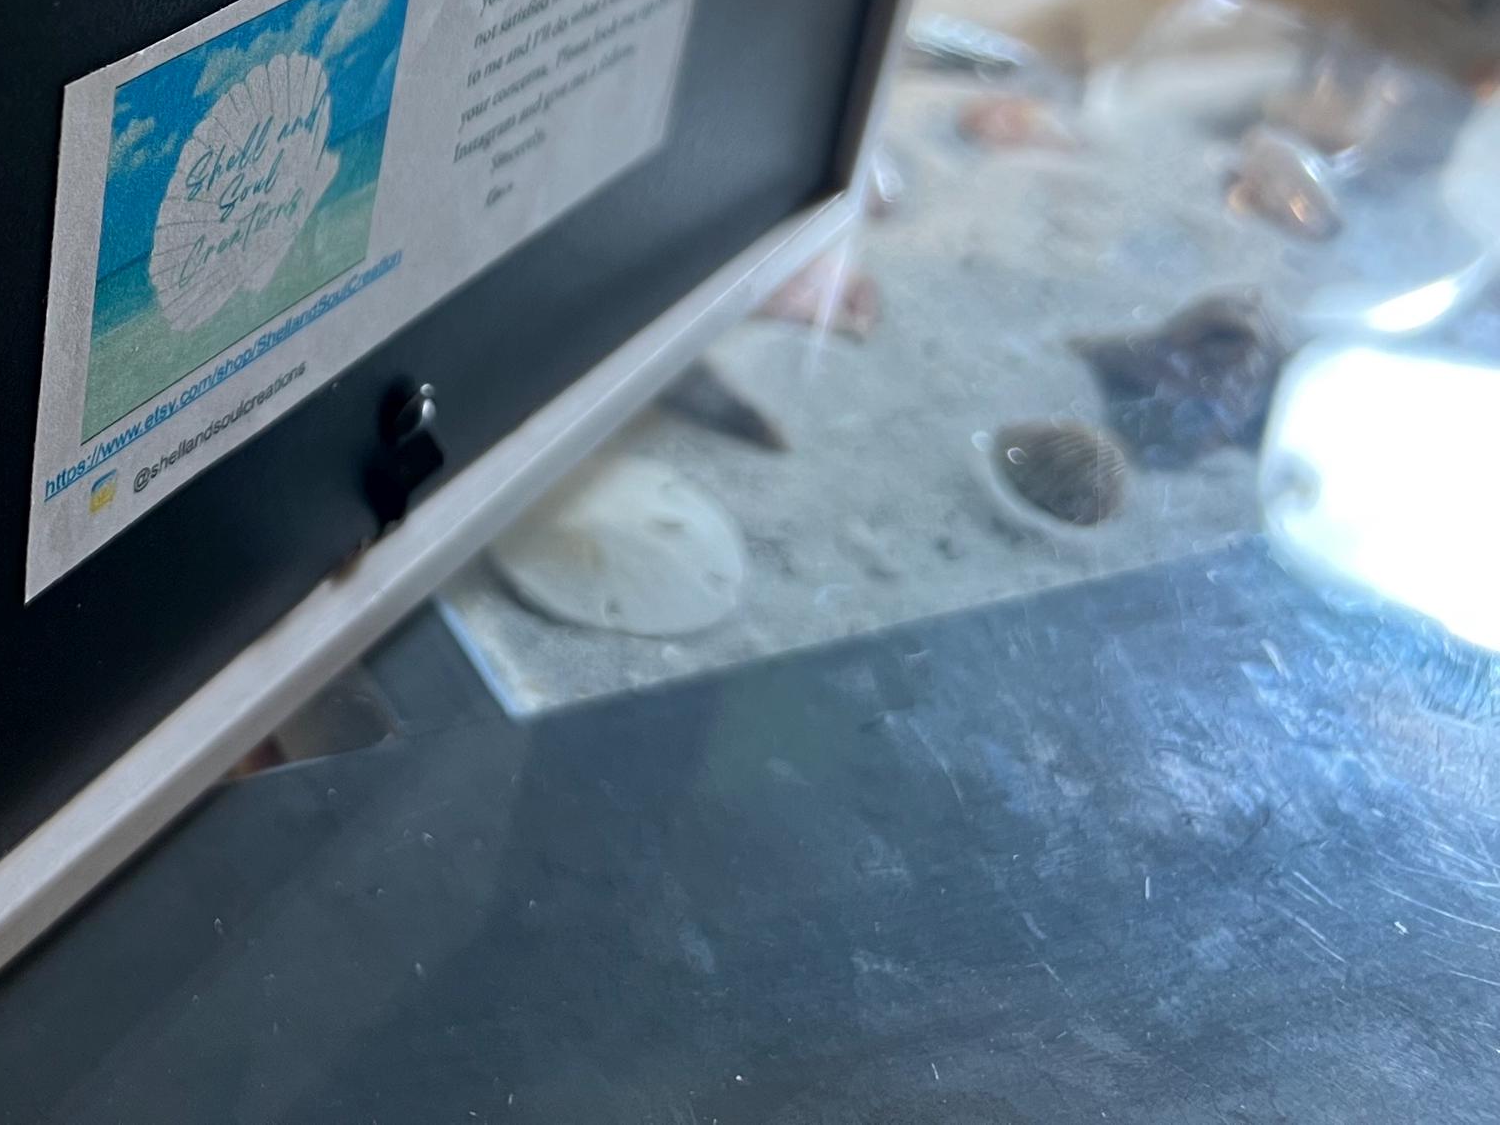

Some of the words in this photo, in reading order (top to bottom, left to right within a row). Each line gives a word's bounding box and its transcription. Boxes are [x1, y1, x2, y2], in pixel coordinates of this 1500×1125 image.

[466, 68, 482, 88] to
[483, 55, 503, 78] me
[504, 32, 532, 66] and
[549, 15, 568, 38] do
[473, 23, 498, 49] not
[452, 114, 517, 164] Instagram
[516, 91, 543, 124] and
[457, 96, 491, 133] your
[184, 115, 273, 202] Shell
[217, 147, 284, 224] Soul
[177, 182, 304, 289] Creations
[132, 362, 306, 493] @shellandsoulcreations
